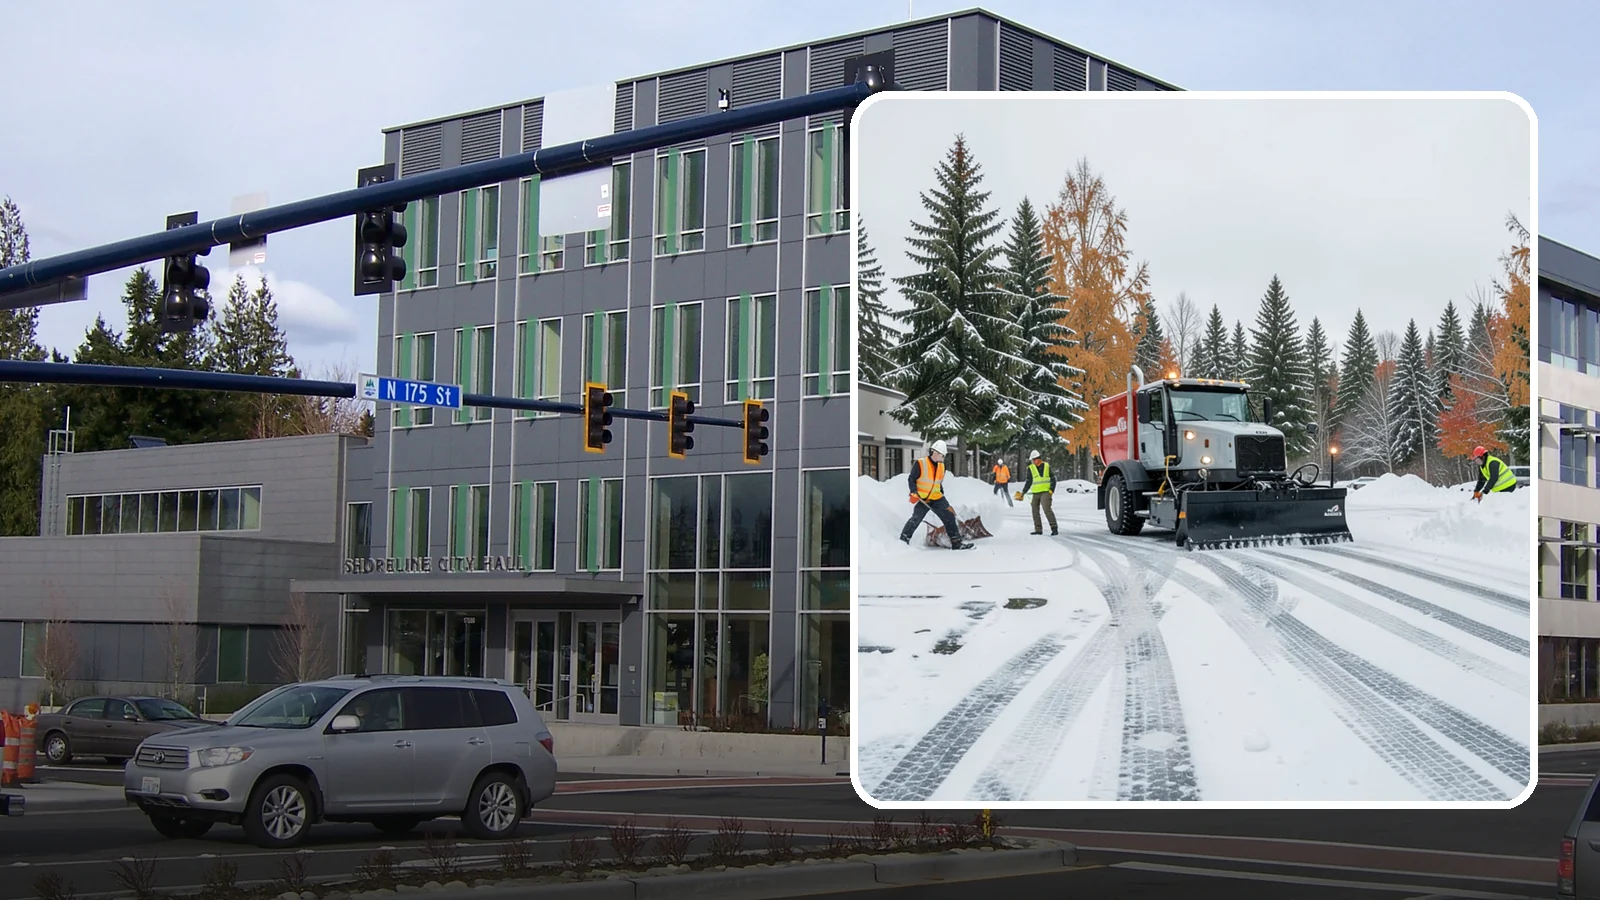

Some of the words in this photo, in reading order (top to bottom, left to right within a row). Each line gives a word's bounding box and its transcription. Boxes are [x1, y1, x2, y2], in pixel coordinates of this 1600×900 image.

[387, 380, 396, 399] N
[405, 382, 427, 403] 175
[436, 386, 451, 406] St
[344, 556, 432, 574] SHORELINE
[438, 556, 474, 573] CITY
[484, 555, 525, 572] HALL
